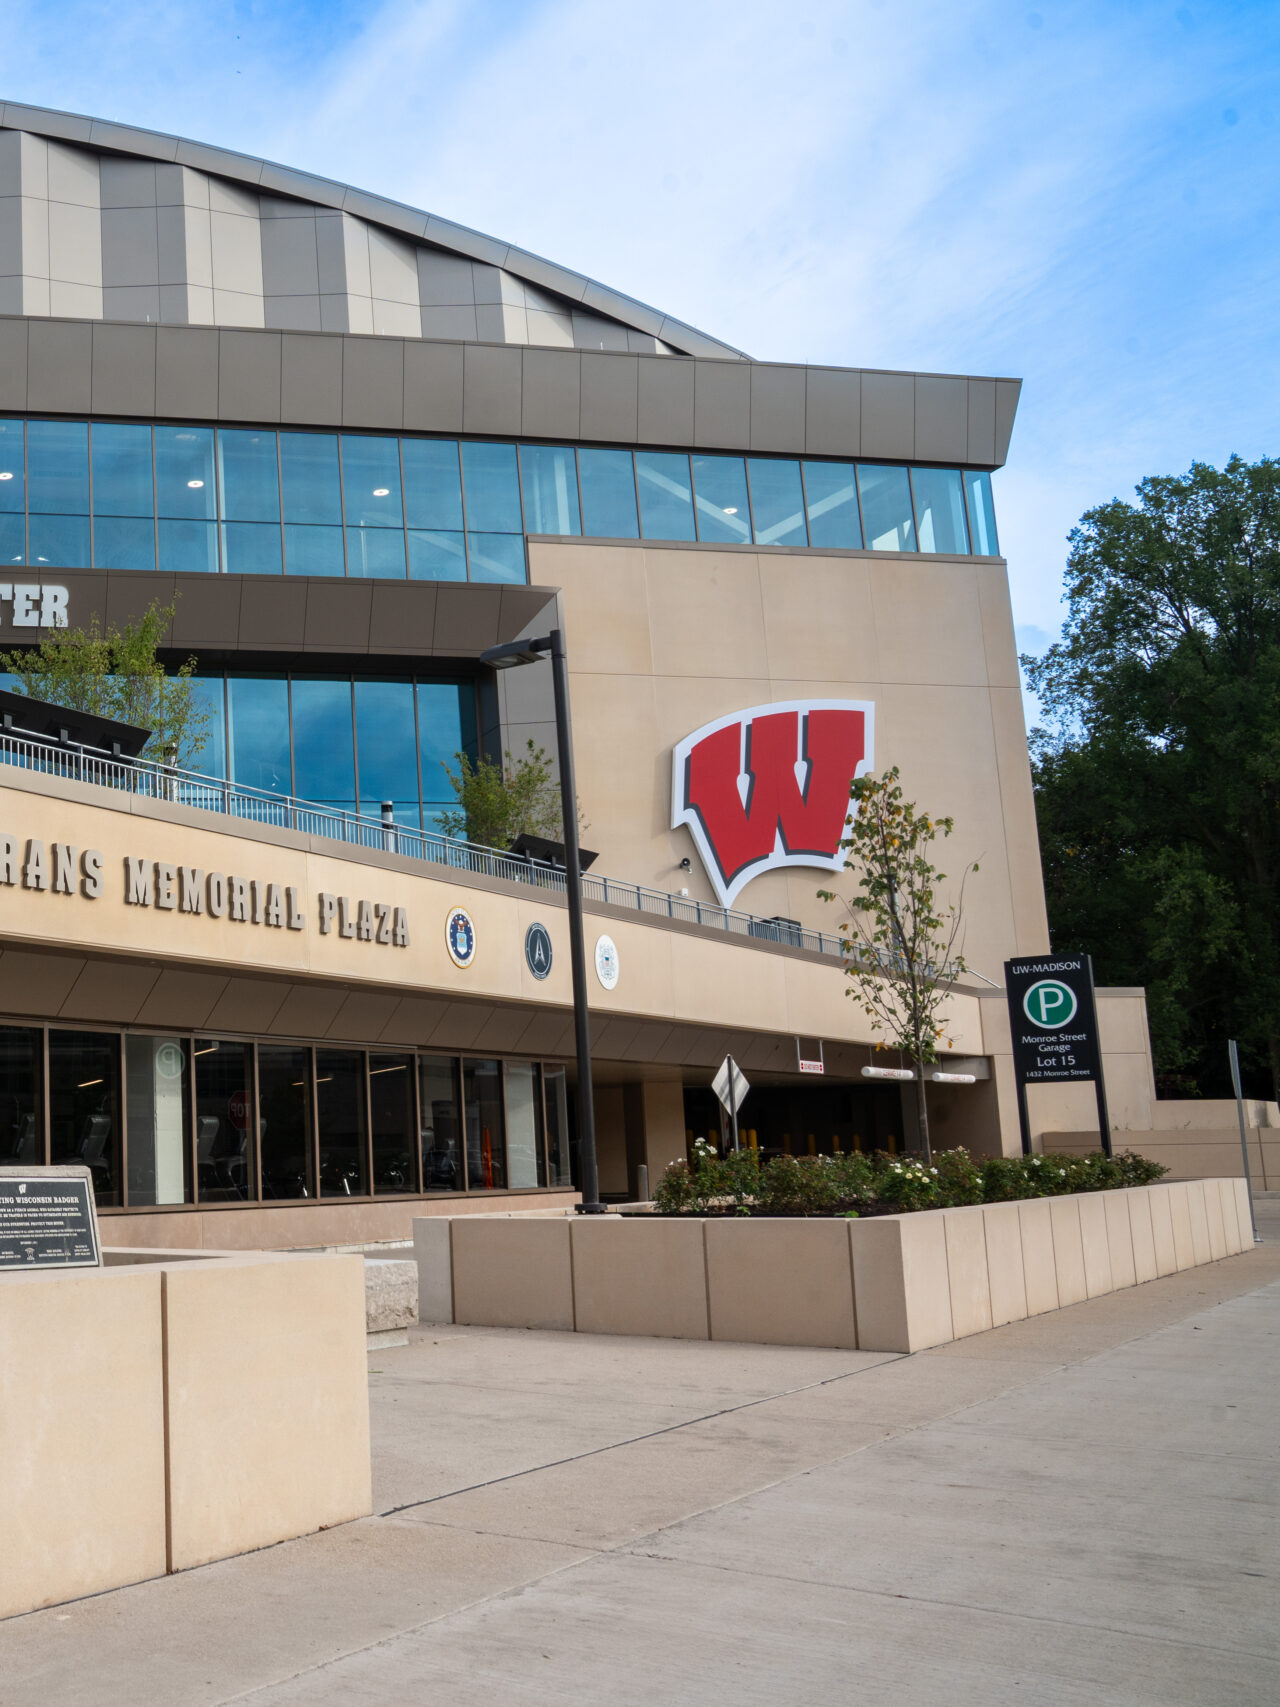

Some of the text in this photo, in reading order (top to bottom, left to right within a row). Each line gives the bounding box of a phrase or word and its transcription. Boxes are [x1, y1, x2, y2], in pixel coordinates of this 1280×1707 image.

[670, 698, 876, 910] W
[124, 856, 306, 930] MEMORIAL
[319, 892, 411, 947] PLAZA
[1012, 961, 1081, 974] UW-MADISON
[1038, 987, 1064, 1022] P
[1021, 1033, 1087, 1044] Monroe Street
[1038, 1044, 1071, 1053] Garage
[1036, 1055, 1076, 1067] Lot 15
[15, 1196, 53, 1204] WISCONSIN
[53, 1196, 80, 1204] BADGER
